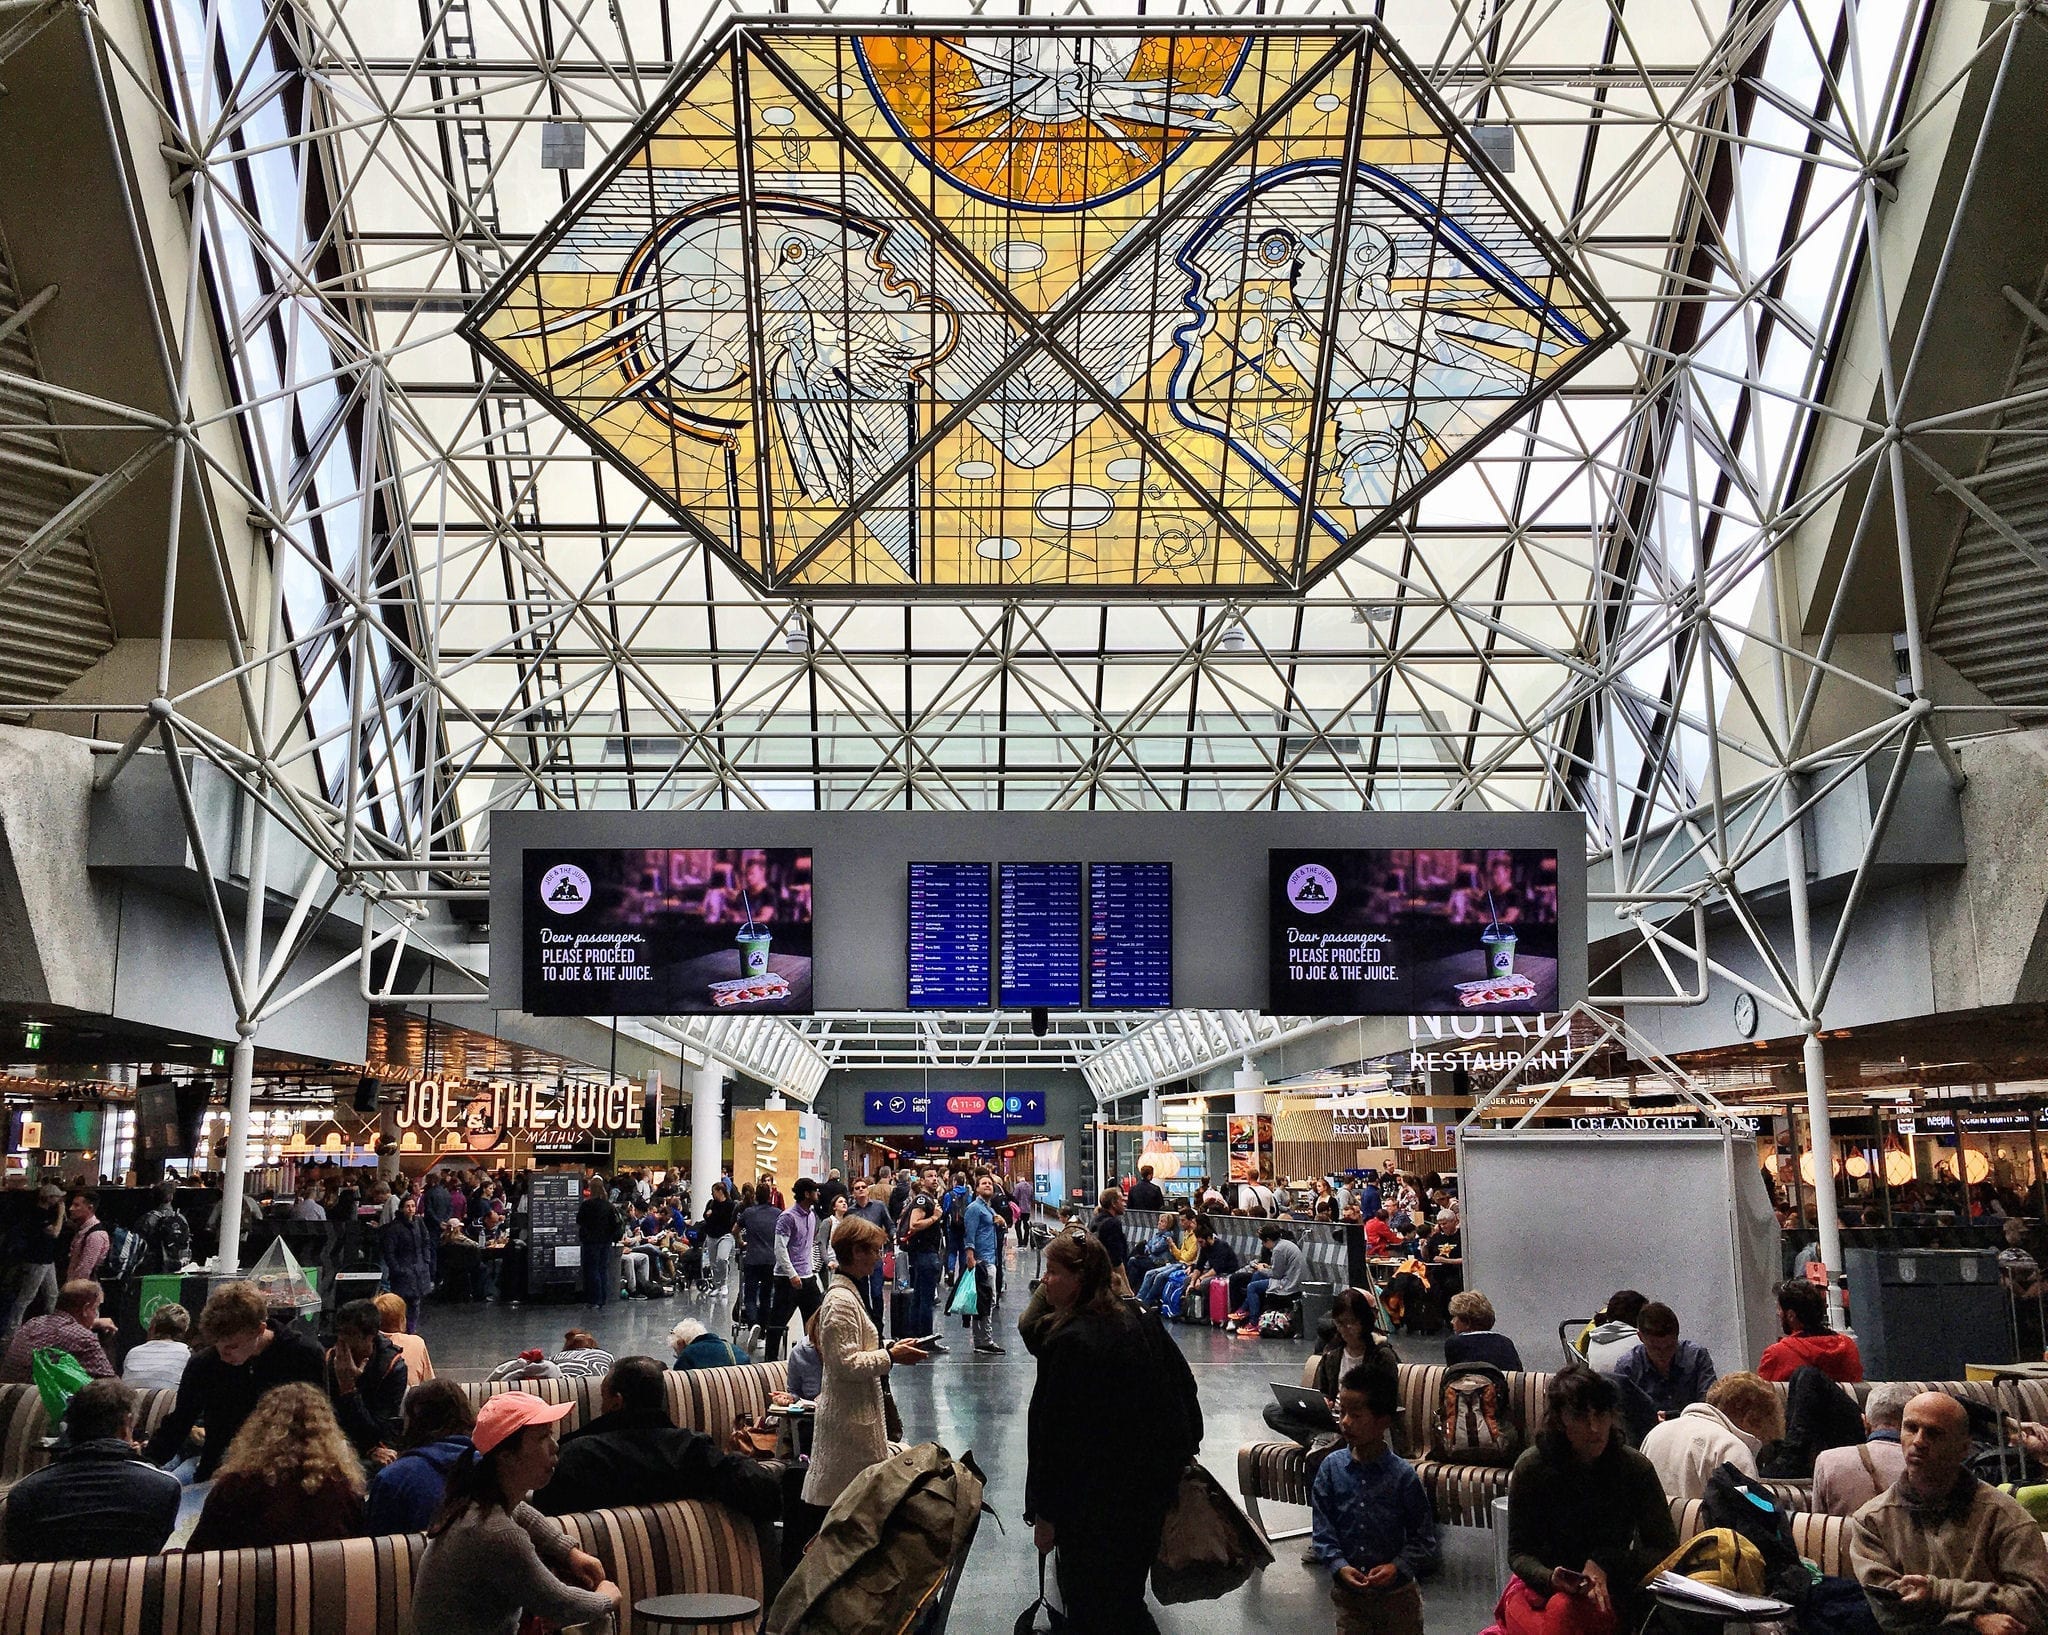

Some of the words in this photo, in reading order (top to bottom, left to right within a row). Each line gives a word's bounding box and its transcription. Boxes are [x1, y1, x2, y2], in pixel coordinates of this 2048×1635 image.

[540, 928, 574, 944] Dear
[1286, 927, 1320, 943] Dear
[542, 949, 583, 963] PLEASE
[585, 948, 635, 963] PROCEED
[1289, 948, 1329, 963] PLEASE
[1331, 948, 1381, 963] PROCEED
[542, 966, 557, 981] TO
[559, 966, 581, 981] JOE
[582, 966, 593, 981] &
[594, 966, 616, 981] THE
[618, 966, 653, 981] JUICE.
[1289, 966, 1303, 980] TO
[1305, 966, 1327, 980] JOE
[1329, 966, 1339, 980] &
[1341, 966, 1362, 980] THE
[1363, 966, 1399, 980] JUICE.
[1410, 1050, 1572, 1072] RESTAURANT
[396, 1080, 461, 1129] JOE
[488, 1081, 547, 1130] THE
[557, 1084, 643, 1130] JUICE
[1010, 1099, 1018, 1108] D
[1570, 1117, 1649, 1131] ICELAND
[1653, 1116, 1697, 1131] GIFT
